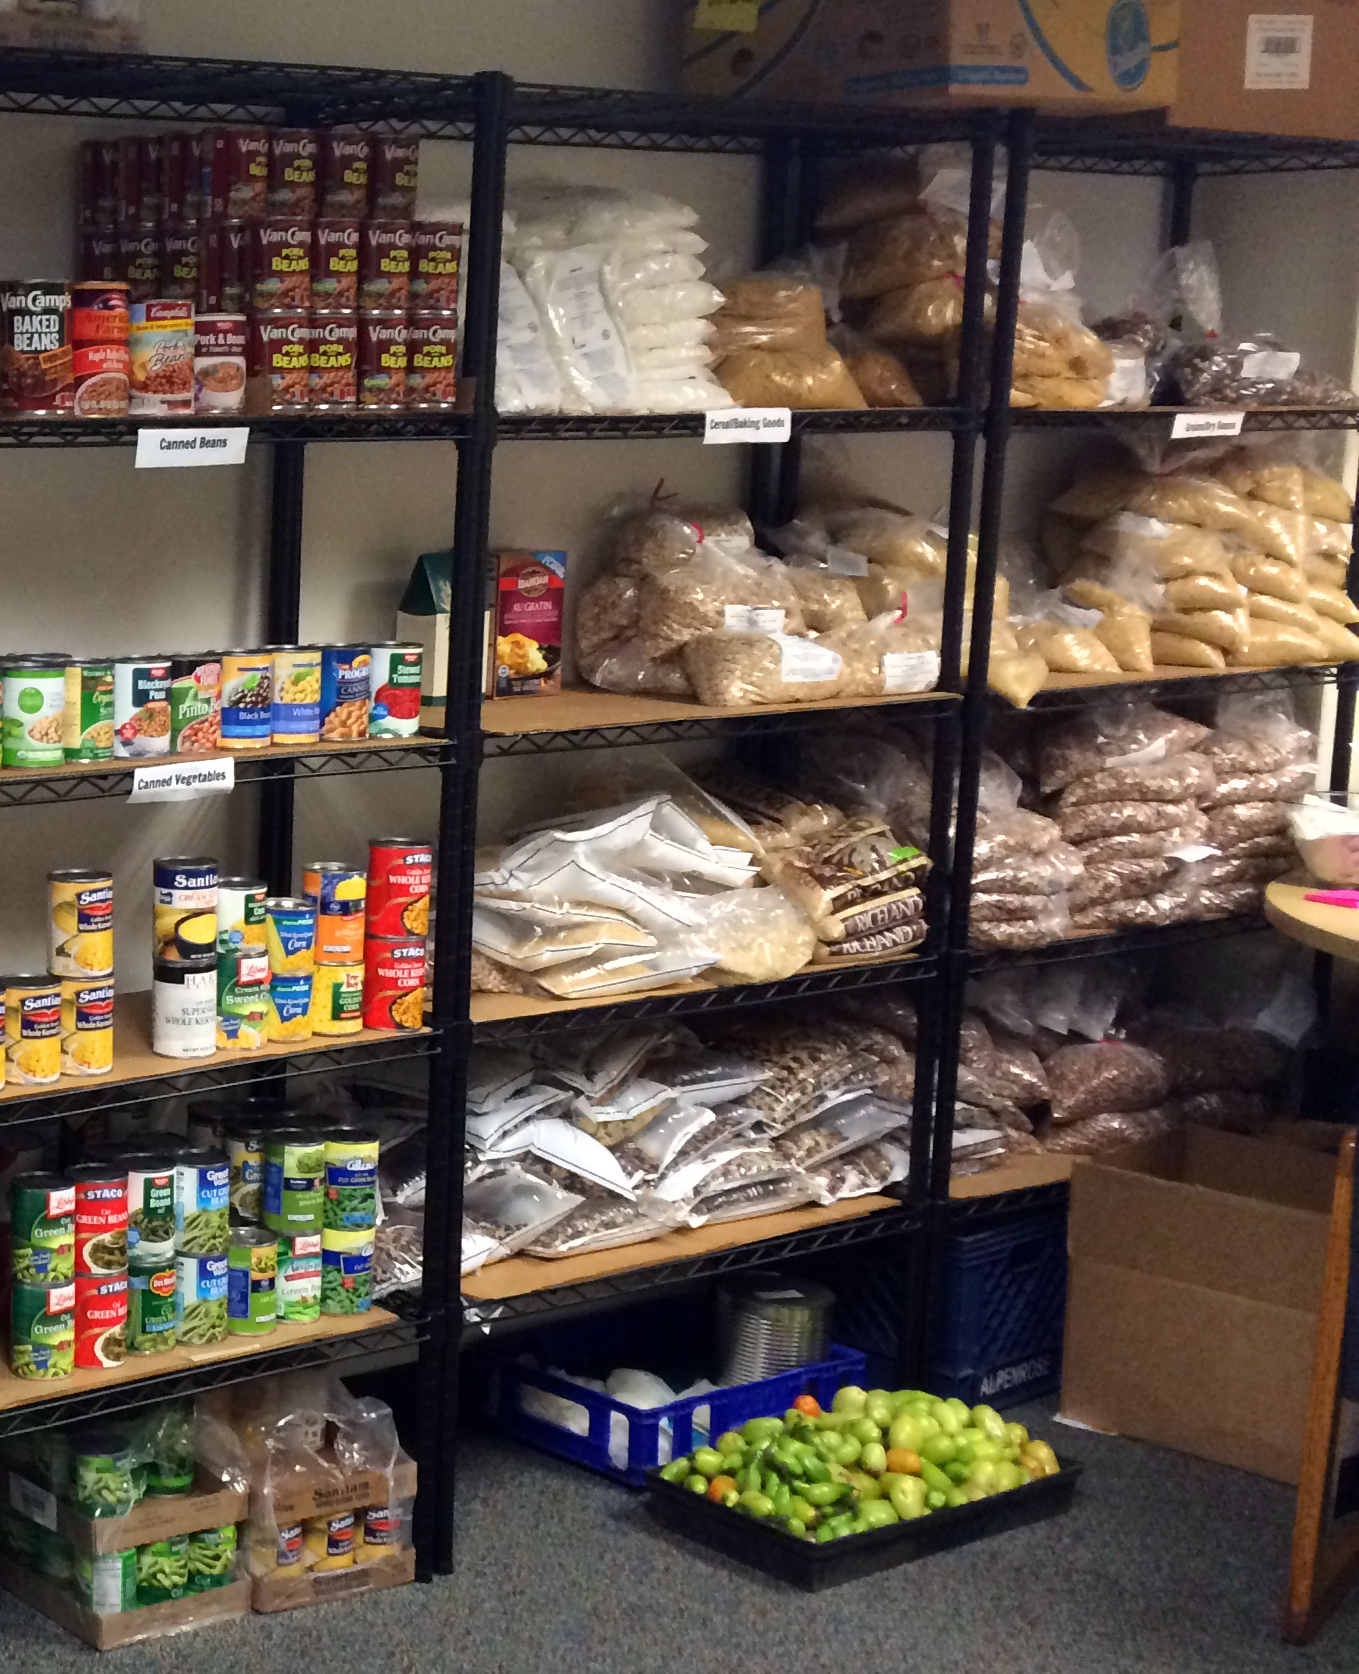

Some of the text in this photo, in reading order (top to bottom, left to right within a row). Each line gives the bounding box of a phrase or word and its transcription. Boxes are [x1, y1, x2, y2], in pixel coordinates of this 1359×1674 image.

[284, 167, 316, 182] BEAN
[330, 257, 358, 272] BEAN
[381, 258, 410, 273] BEAN
[1, 292, 25, 312] Van
[13, 315, 59, 333] BAKED
[429, 325, 456, 342] Camp
[13, 333, 59, 351] BEANS
[381, 354, 407, 367] BEA
[762, 417, 785, 428] Goods
[159, 437, 228, 450] Canned Beans
[178, 702, 209, 719] Pinto
[239, 710, 258, 720] Black
[138, 769, 226, 791] Canned Vegetables
[174, 874, 219, 887] Santi
[288, 940, 306, 950] Corn
[378, 967, 409, 977] WHOLE
[226, 995, 258, 1005] Sweet
[283, 1005, 302, 1016] Corn
[87, 1188, 123, 1199] STACO
[150, 1188, 171, 1198] Green
[149, 1198, 171, 1208] Beans
[76, 1213, 106, 1224] GREEN
[34, 1226, 66, 1238] Green
[87, 1309, 117, 1320] GREEN
[34, 1322, 66, 1335] Green
